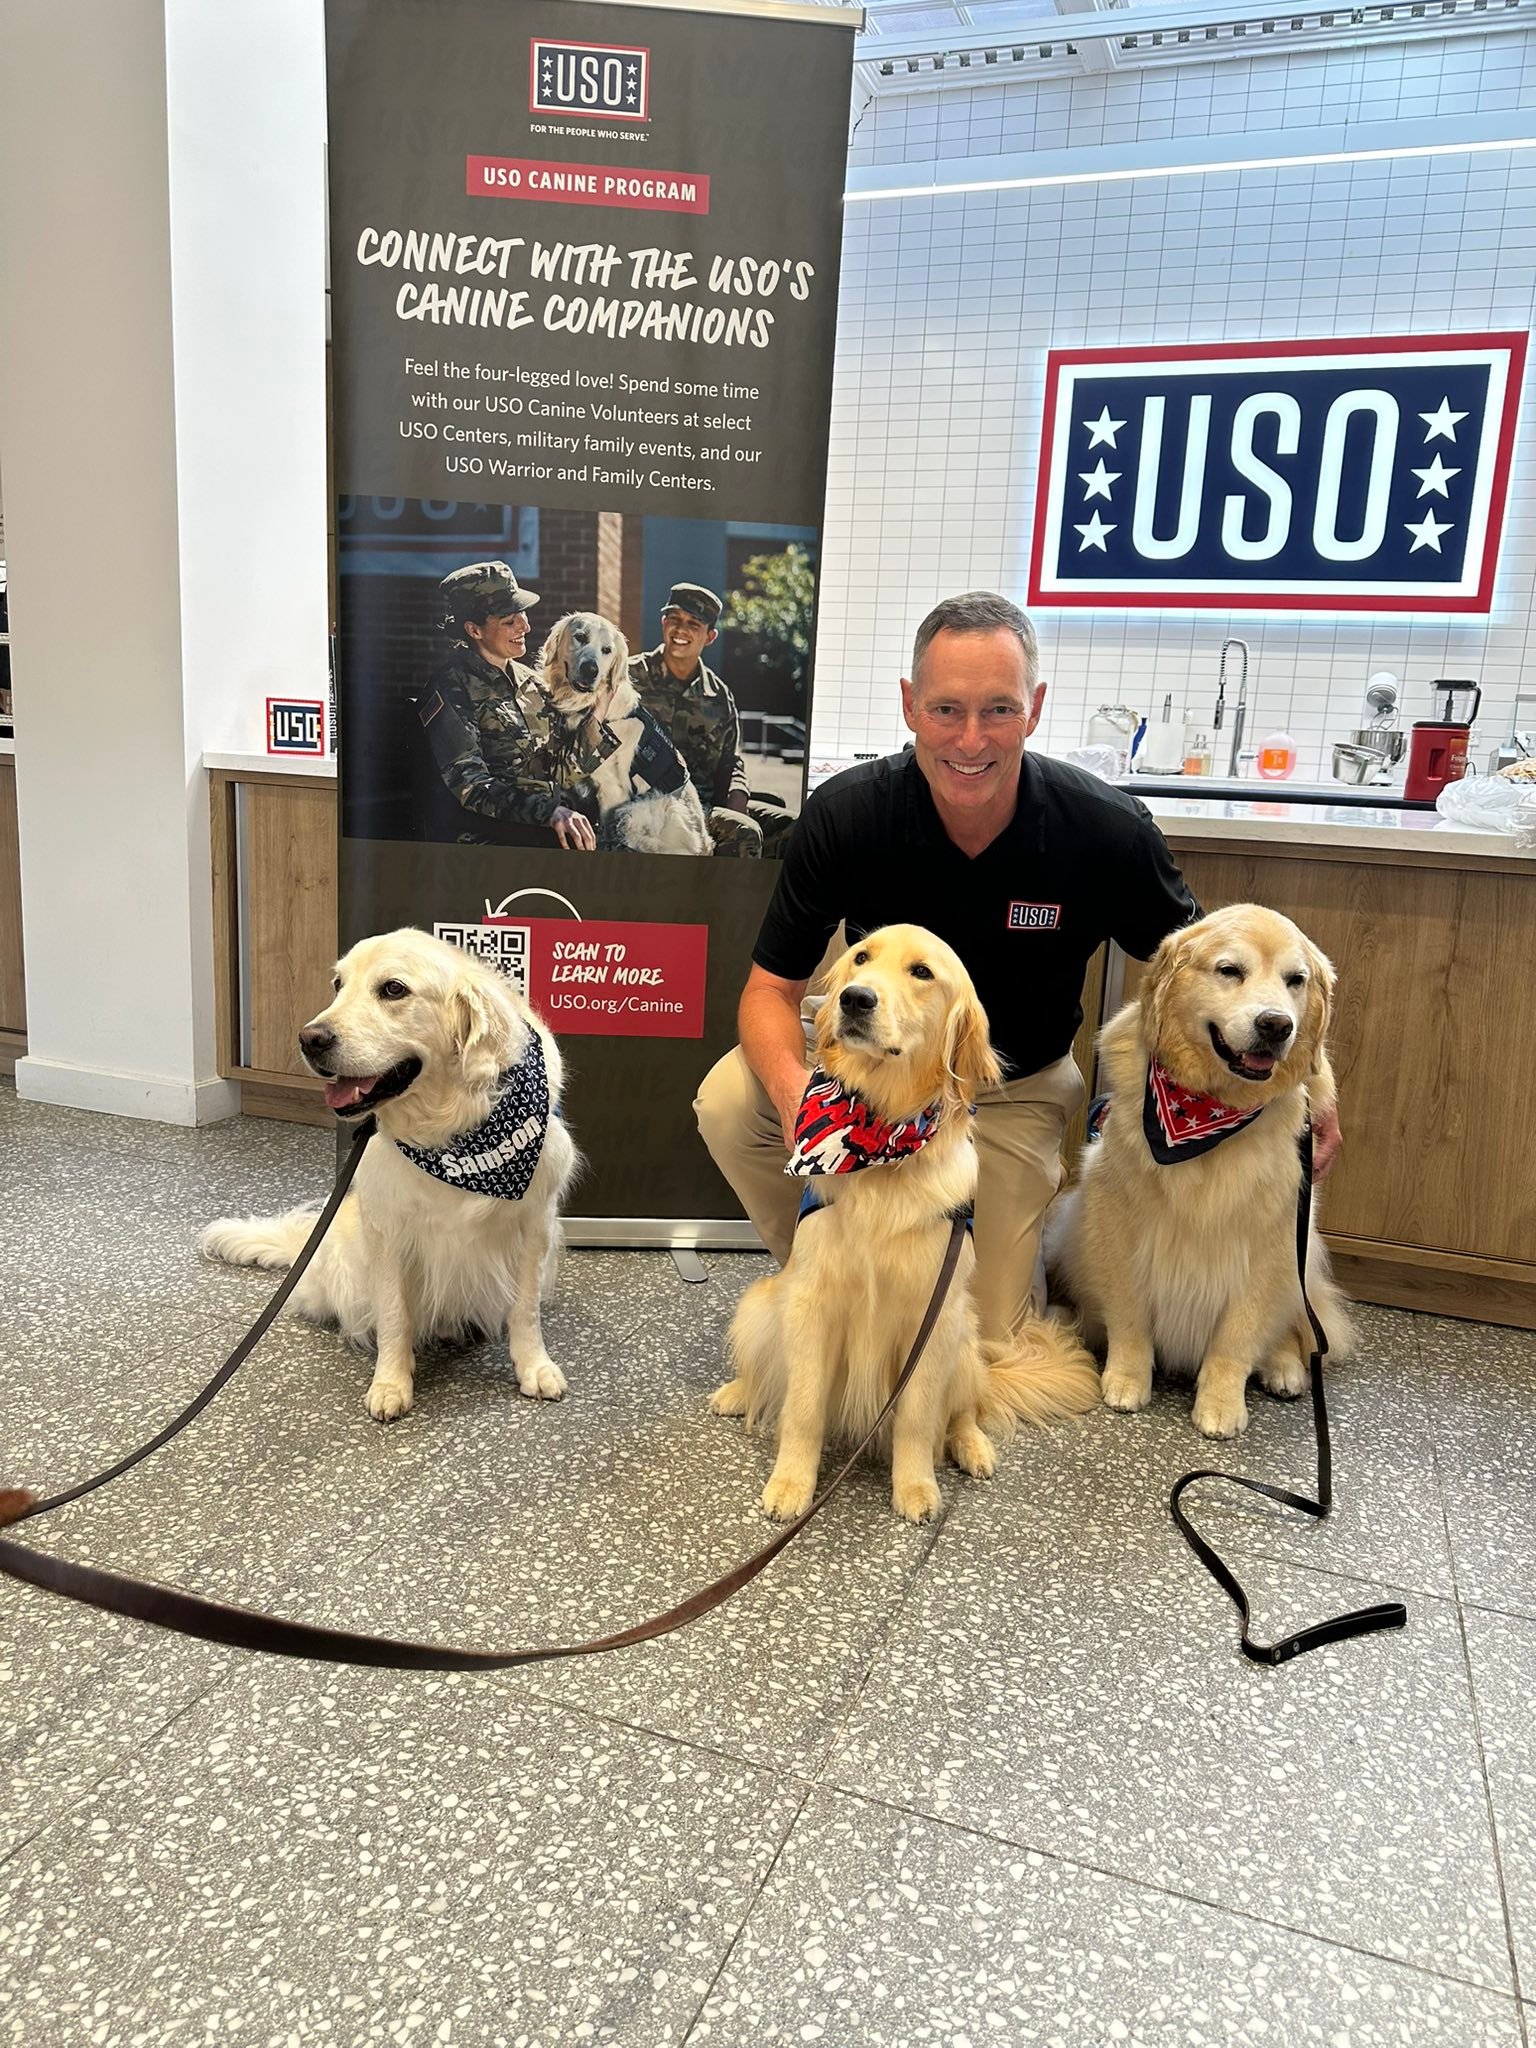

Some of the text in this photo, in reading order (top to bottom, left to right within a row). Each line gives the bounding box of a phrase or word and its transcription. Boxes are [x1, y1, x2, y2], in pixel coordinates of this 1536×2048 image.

[557, 53, 623, 106] USO
[530, 124, 547, 133] FOR
[548, 125, 564, 134] THE
[565, 127, 596, 137] PEOPLE
[597, 129, 618, 139] WHO
[483, 167, 696, 202] USO CANINE PROGRAM
[357, 227, 815, 301] CONNECT WITH THE USO'S
[396, 282, 775, 348] CANINE COMPANIONS
[405, 358, 760, 400] Feel the four-legged love! Spend some time
[411, 392, 752, 431] with our USO Canine Volunteers at select
[400, 421, 762, 462] USO Centers, military family events, and our
[446, 456, 716, 491] USO Warrior and Family Centers.
[1132, 389, 1400, 562] USO
[276, 711, 319, 742] USO
[1019, 906, 1049, 926] USO
[552, 941, 626, 962] SCAN TO
[551, 965, 664, 986] LEARN MORE
[550, 994, 683, 1014] USO.org/Canine
[441, 1115, 542, 1177] Samson
